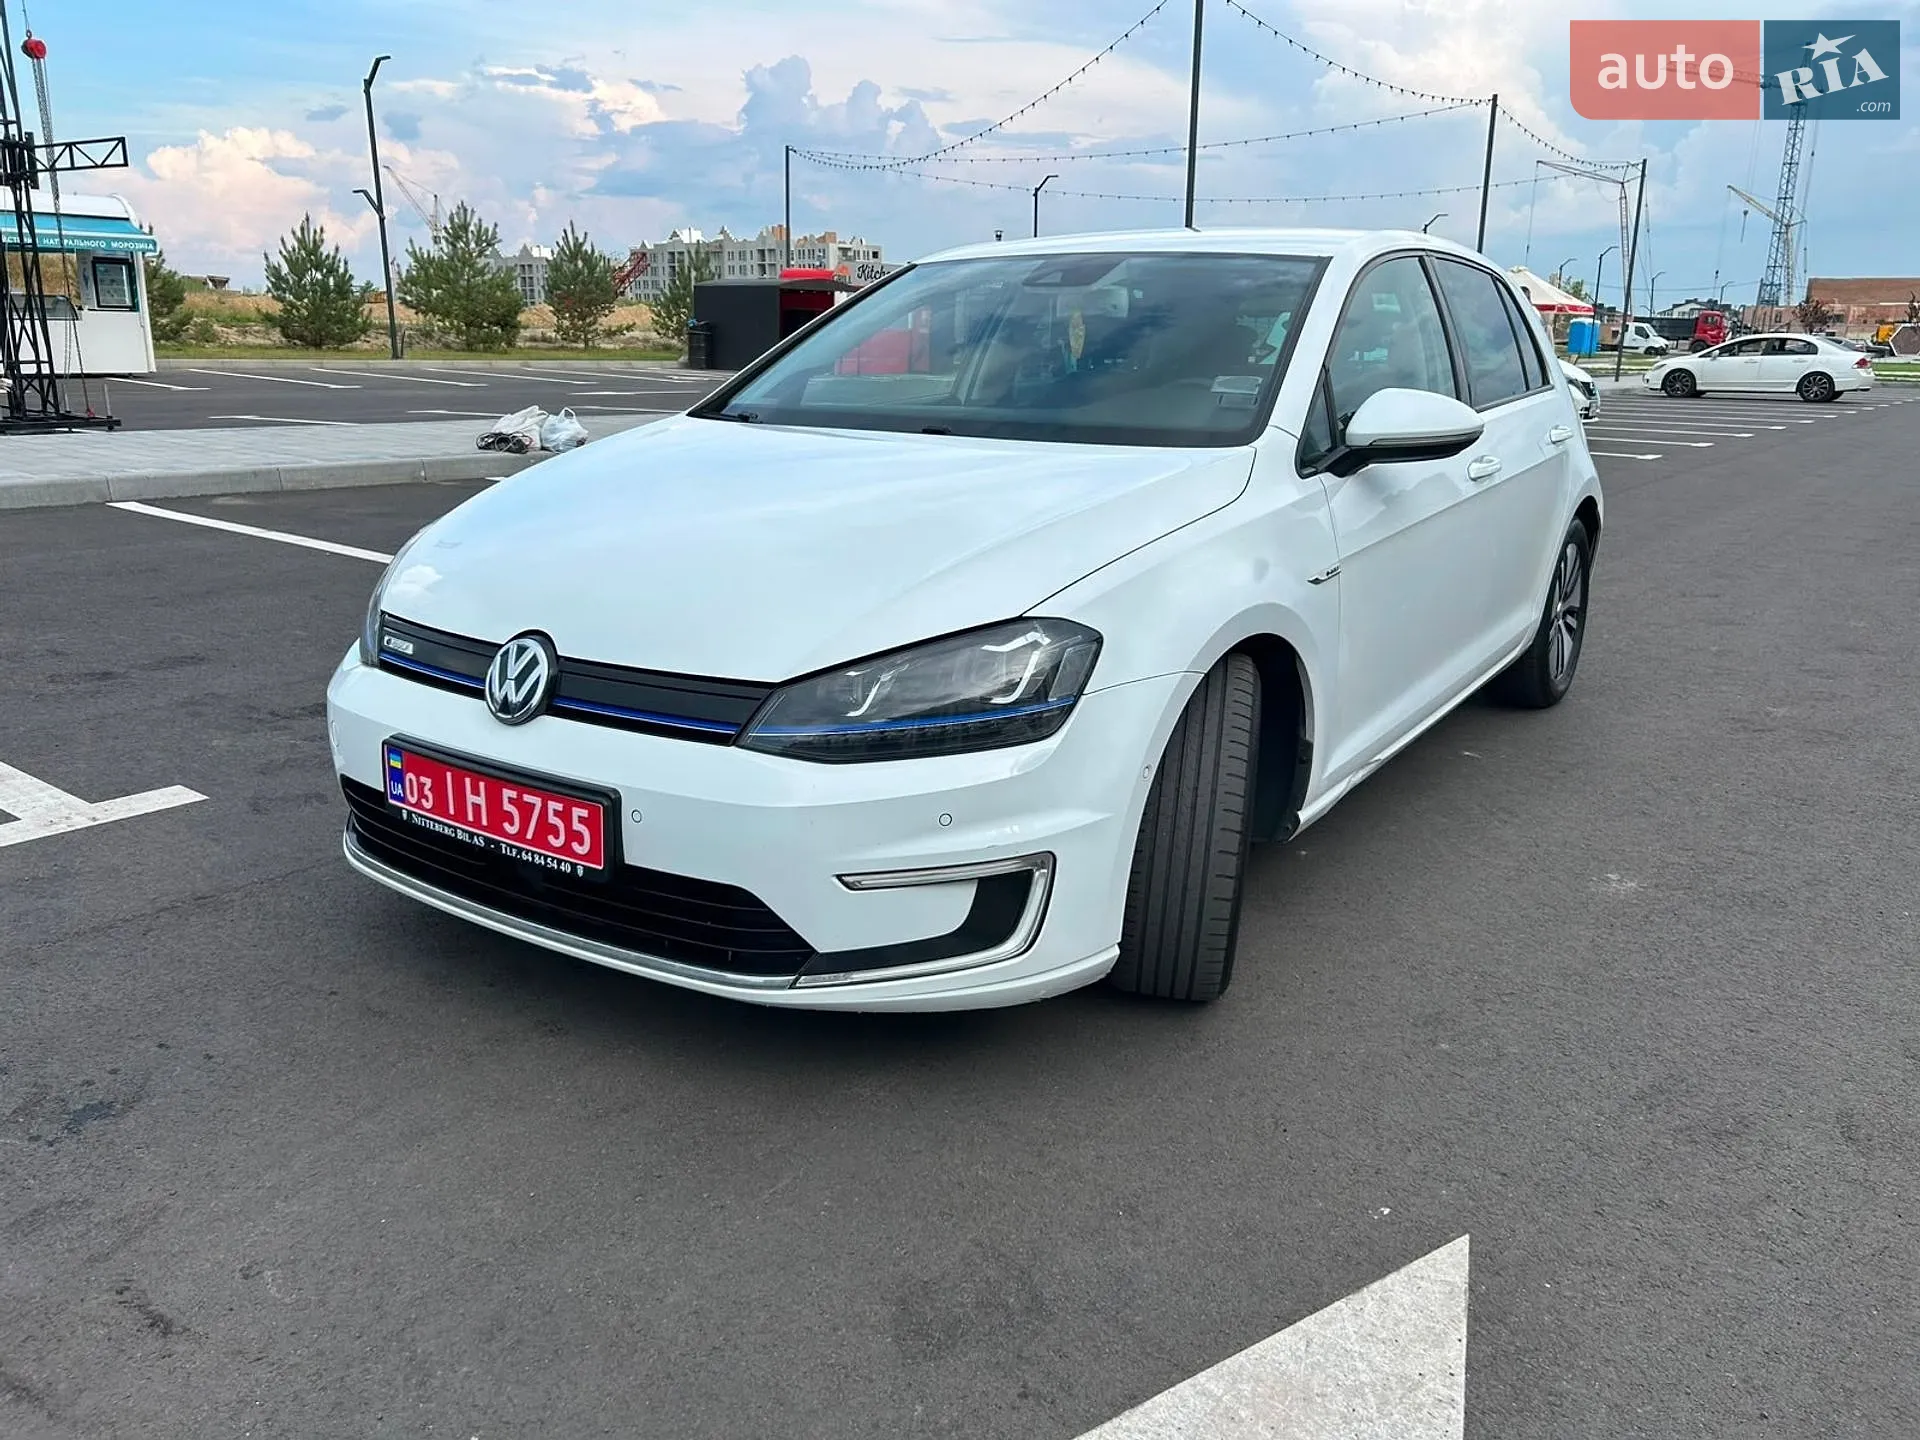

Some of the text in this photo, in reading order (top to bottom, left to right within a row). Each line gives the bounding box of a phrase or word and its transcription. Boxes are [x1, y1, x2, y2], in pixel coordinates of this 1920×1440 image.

[43, 237, 106, 248] НАТРАЛЬНОГО
[390, 780, 404, 797] UA
[406, 772, 434, 810] 03
[502, 788, 591, 856] 5755
[472, 835, 486, 847] AS
